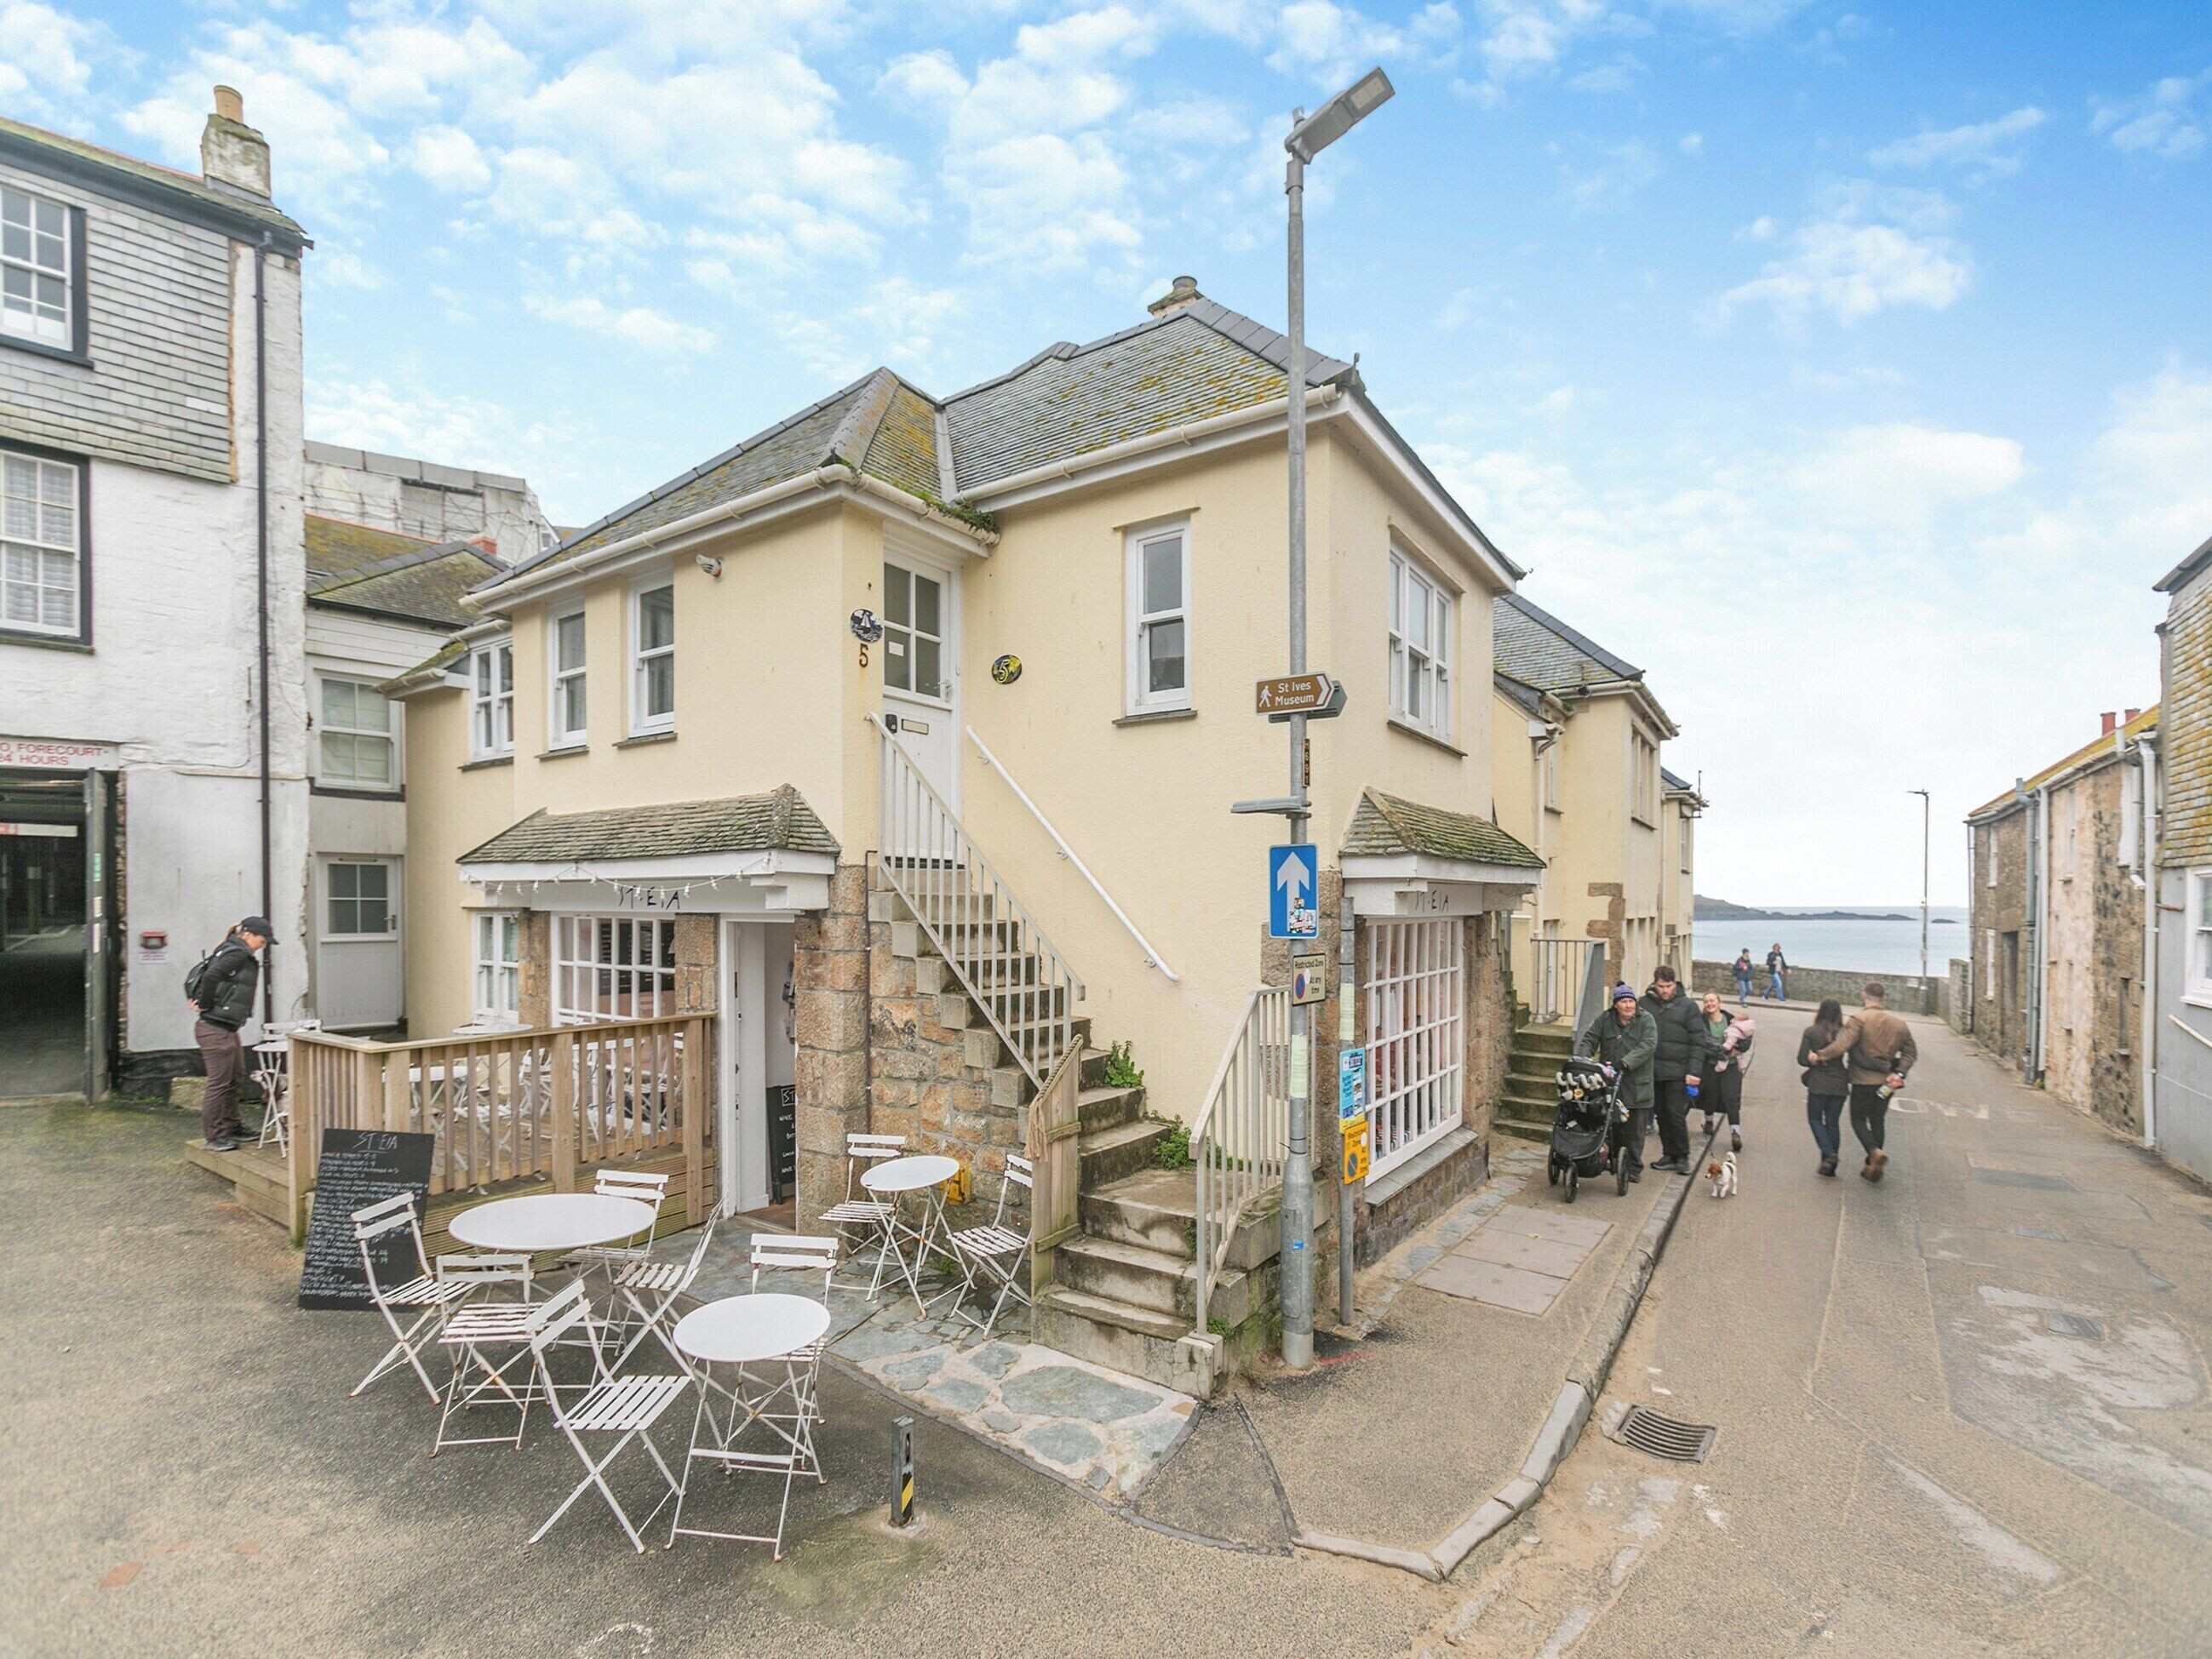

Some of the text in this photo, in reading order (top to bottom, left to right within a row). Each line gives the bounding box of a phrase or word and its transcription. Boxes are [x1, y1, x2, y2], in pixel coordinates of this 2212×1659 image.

[859, 644, 868, 668] 5
[996, 659, 1011, 684] 5
[1278, 682, 1311, 693] St Ives
[1275, 695, 1315, 707] Museum
[17, 743, 102, 757] FORECOURT
[20, 754, 70, 765] HOURS
